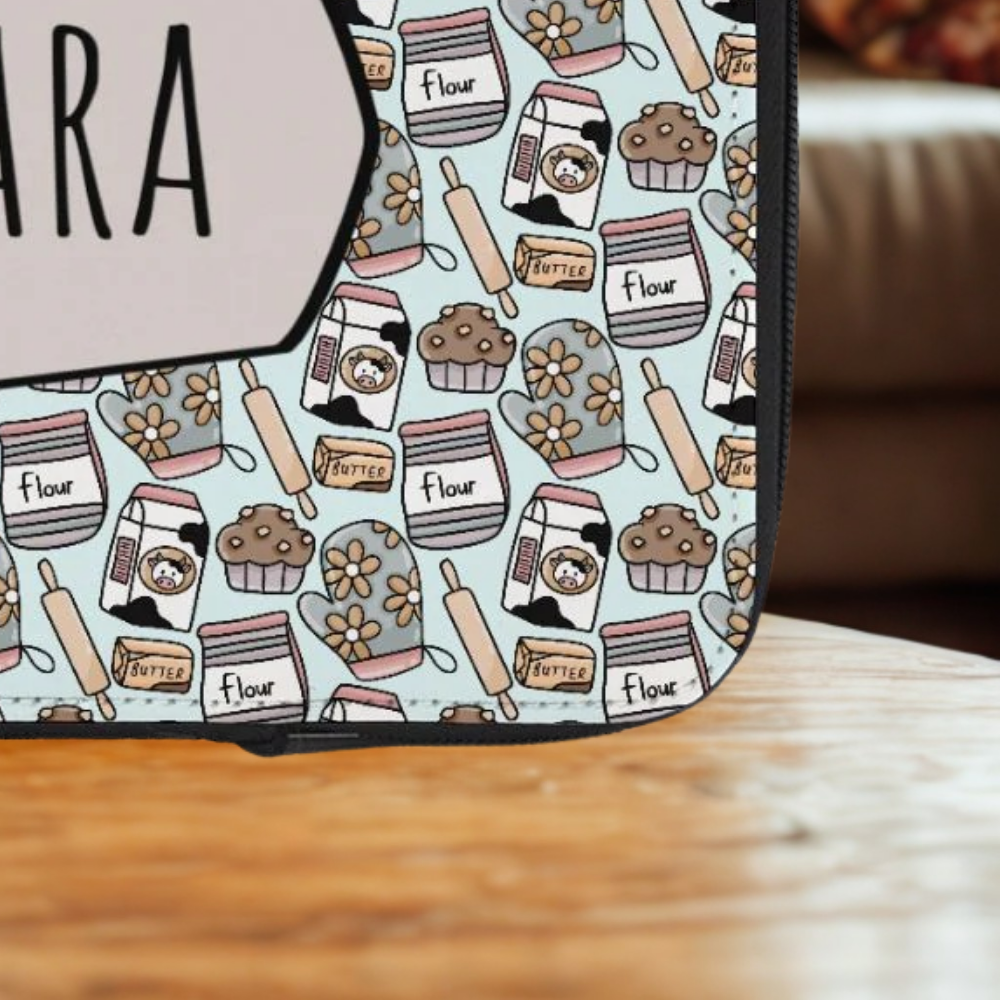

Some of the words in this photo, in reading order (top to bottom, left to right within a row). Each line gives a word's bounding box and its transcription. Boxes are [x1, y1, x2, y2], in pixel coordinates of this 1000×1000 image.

[419, 69, 476, 101] flour
[532, 259, 587, 279] BUTTER
[620, 270, 677, 302] flour
[331, 460, 386, 480] BUTTER
[17, 471, 74, 503] flour
[419, 471, 476, 503] flour
[130, 661, 185, 681] BUTTER
[532, 661, 587, 681] BUTTER
[218, 672, 275, 704] flour
[620, 672, 677, 704] flour
